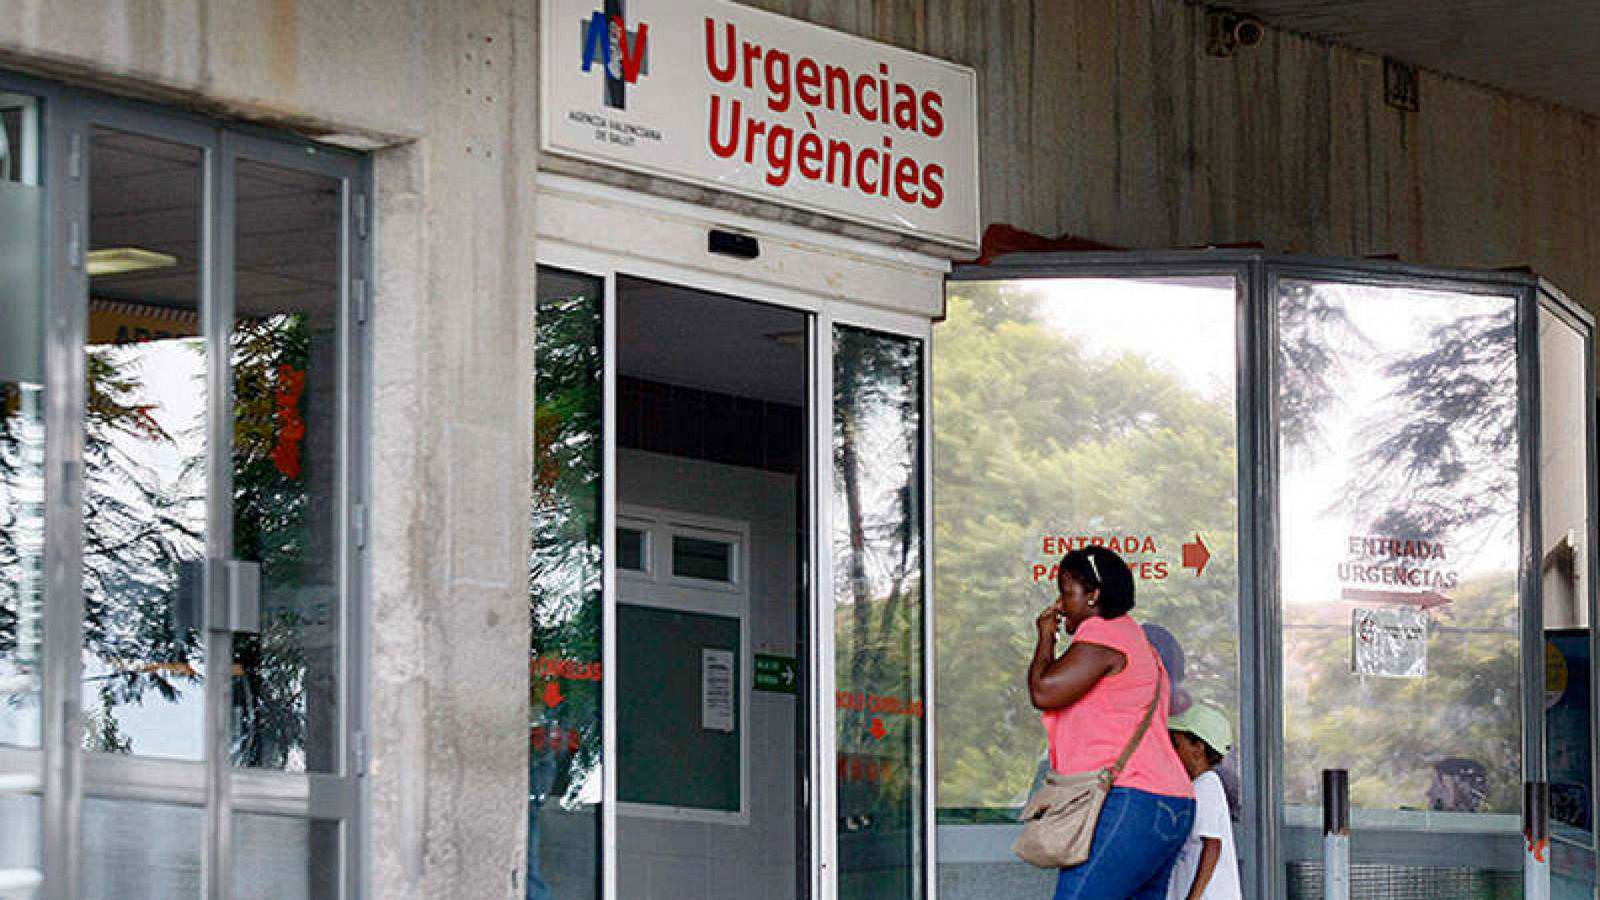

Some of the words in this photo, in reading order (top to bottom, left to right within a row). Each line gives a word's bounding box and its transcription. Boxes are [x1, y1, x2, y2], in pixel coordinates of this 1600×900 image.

[705, 17, 944, 138] Urgencias
[708, 94, 944, 209] Urgències
[1337, 561, 1458, 589] URGENCIAS
[1348, 535, 1447, 560] ENTRADA
